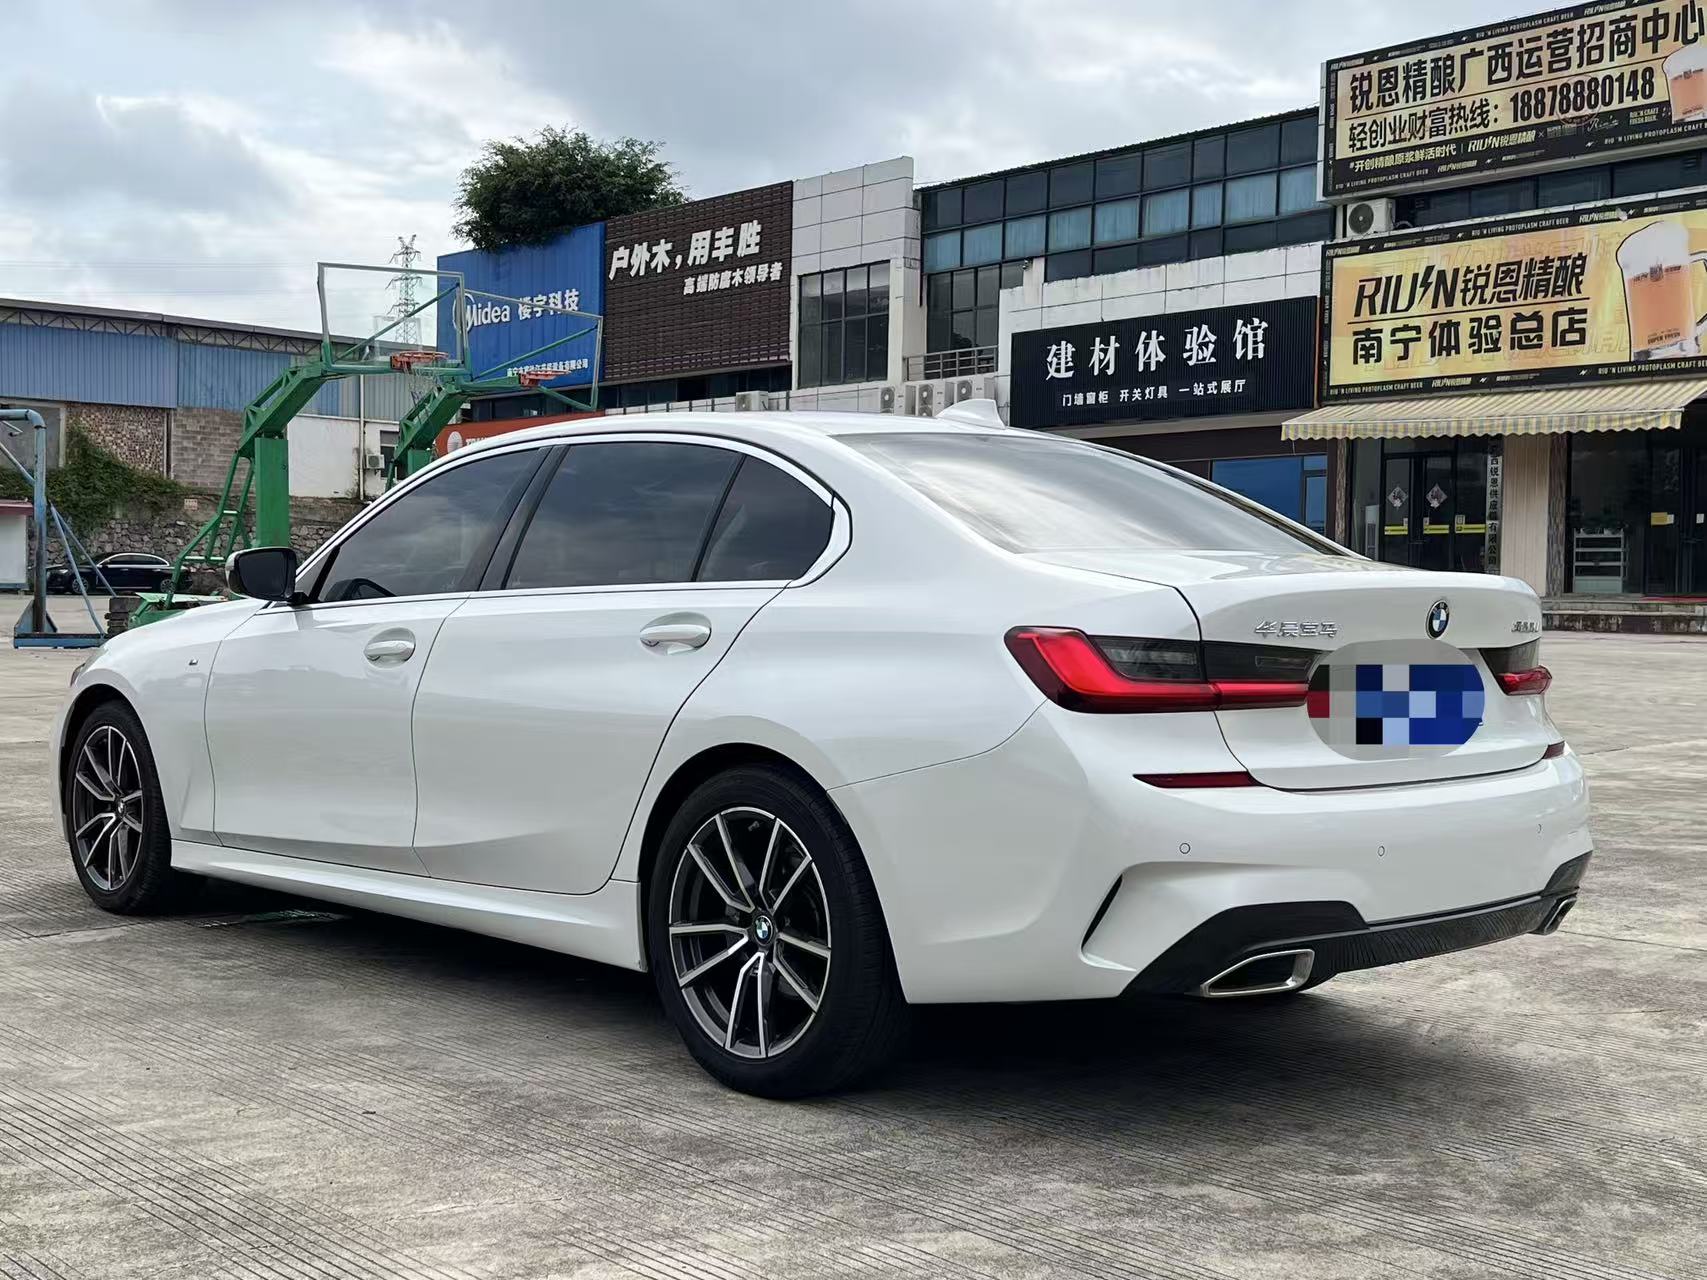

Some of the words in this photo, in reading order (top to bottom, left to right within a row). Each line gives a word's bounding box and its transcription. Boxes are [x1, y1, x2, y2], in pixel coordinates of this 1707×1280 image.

[1350, 0, 1705, 114] 锐恩精酿广西运营招商中心
[1510, 67, 1655, 122] 18878880148
[683, 261, 783, 296] 高端防腐木领导者
[465, 302, 511, 327] Midea
[1352, 307, 1588, 365] 南宁体验总店
[1046, 317, 1269, 381] 建材体验馆
[1062, 390, 1109, 407] 门墙窗柜
[1119, 386, 1168, 402] 开关灯具
[1179, 379, 1246, 397] 一站式展厅
